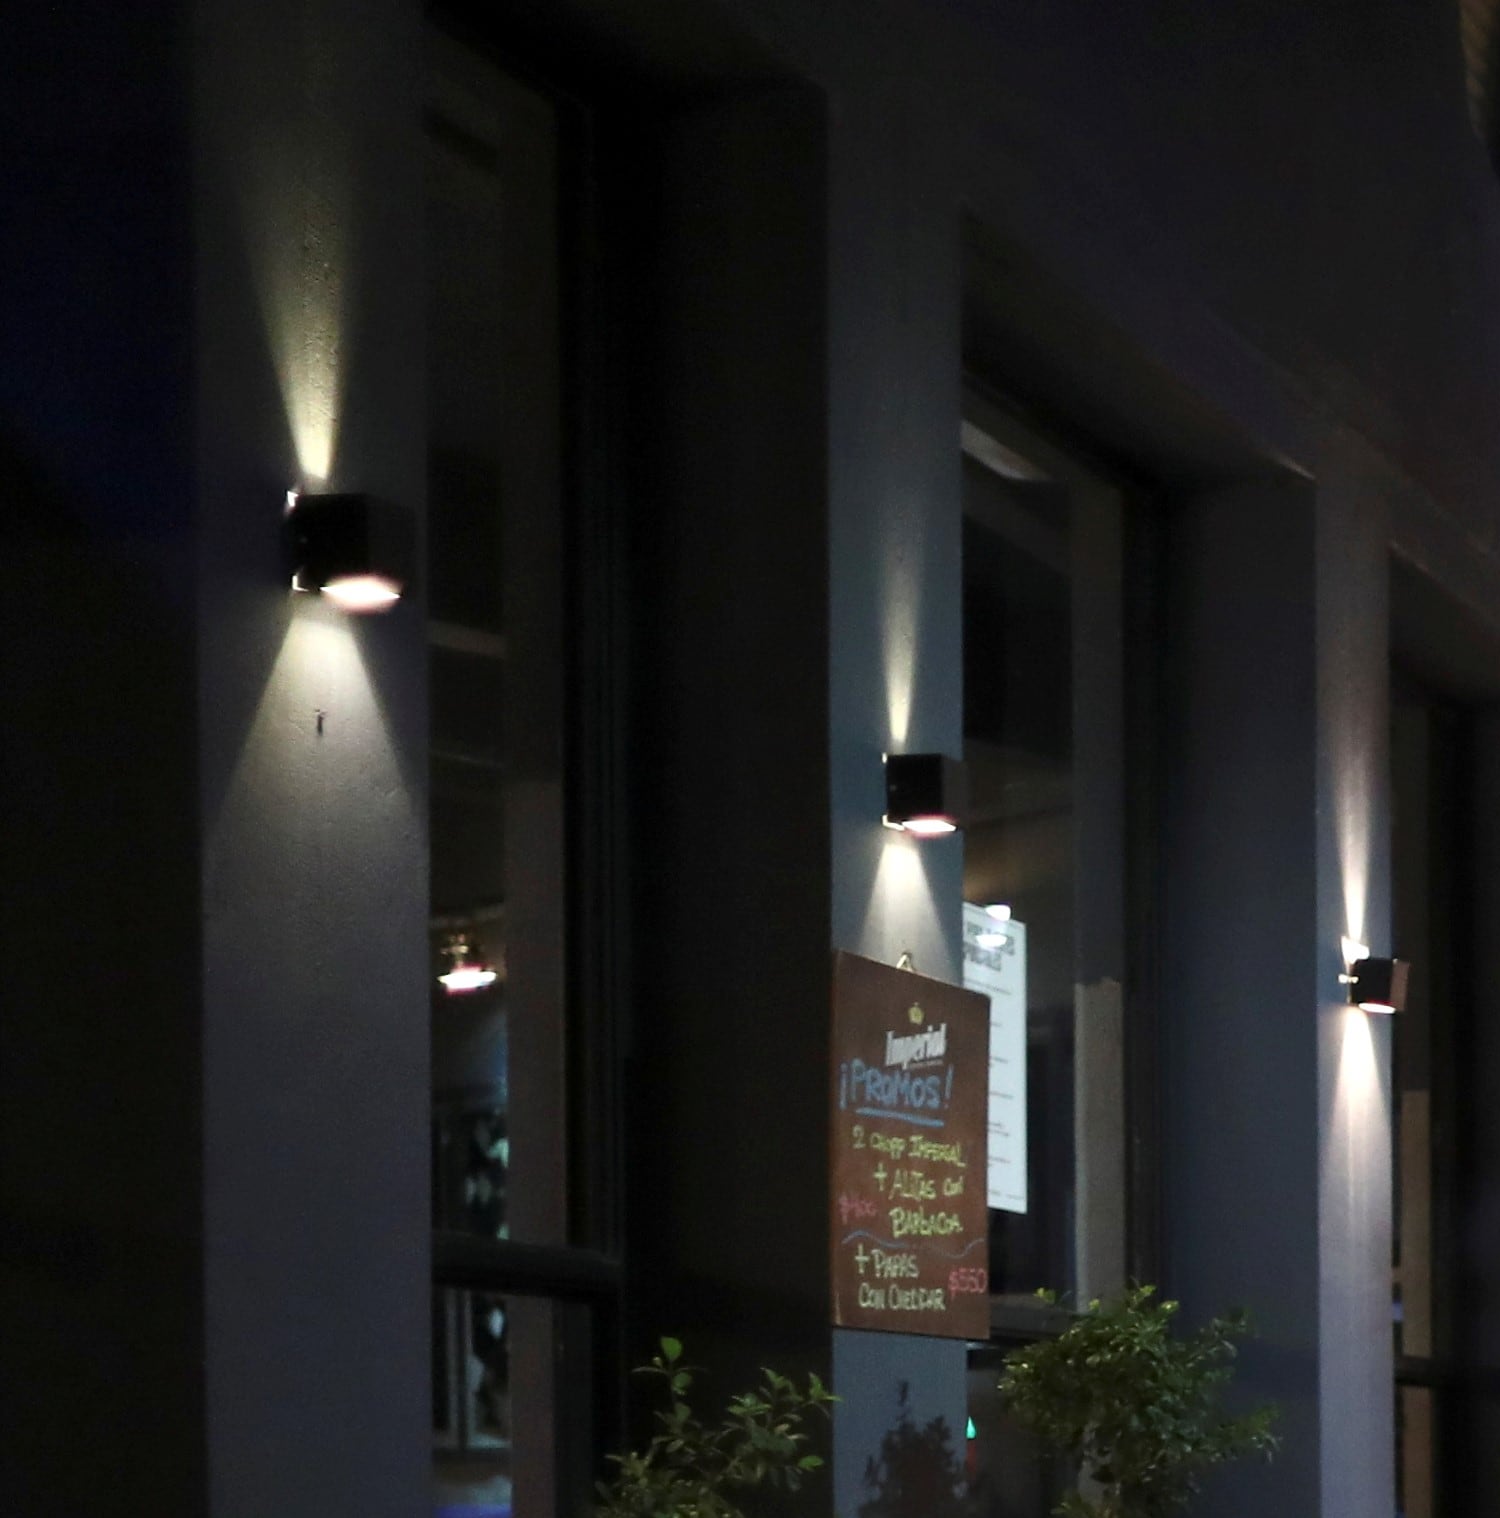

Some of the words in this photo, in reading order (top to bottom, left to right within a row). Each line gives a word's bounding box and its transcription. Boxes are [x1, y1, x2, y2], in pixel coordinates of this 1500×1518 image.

[885, 1023, 948, 1070] Imperial
[852, 1125, 866, 1149] 2
[873, 1162, 888, 1193] +
[854, 1242, 869, 1275] +
[871, 1248, 921, 1279] PAPAS
